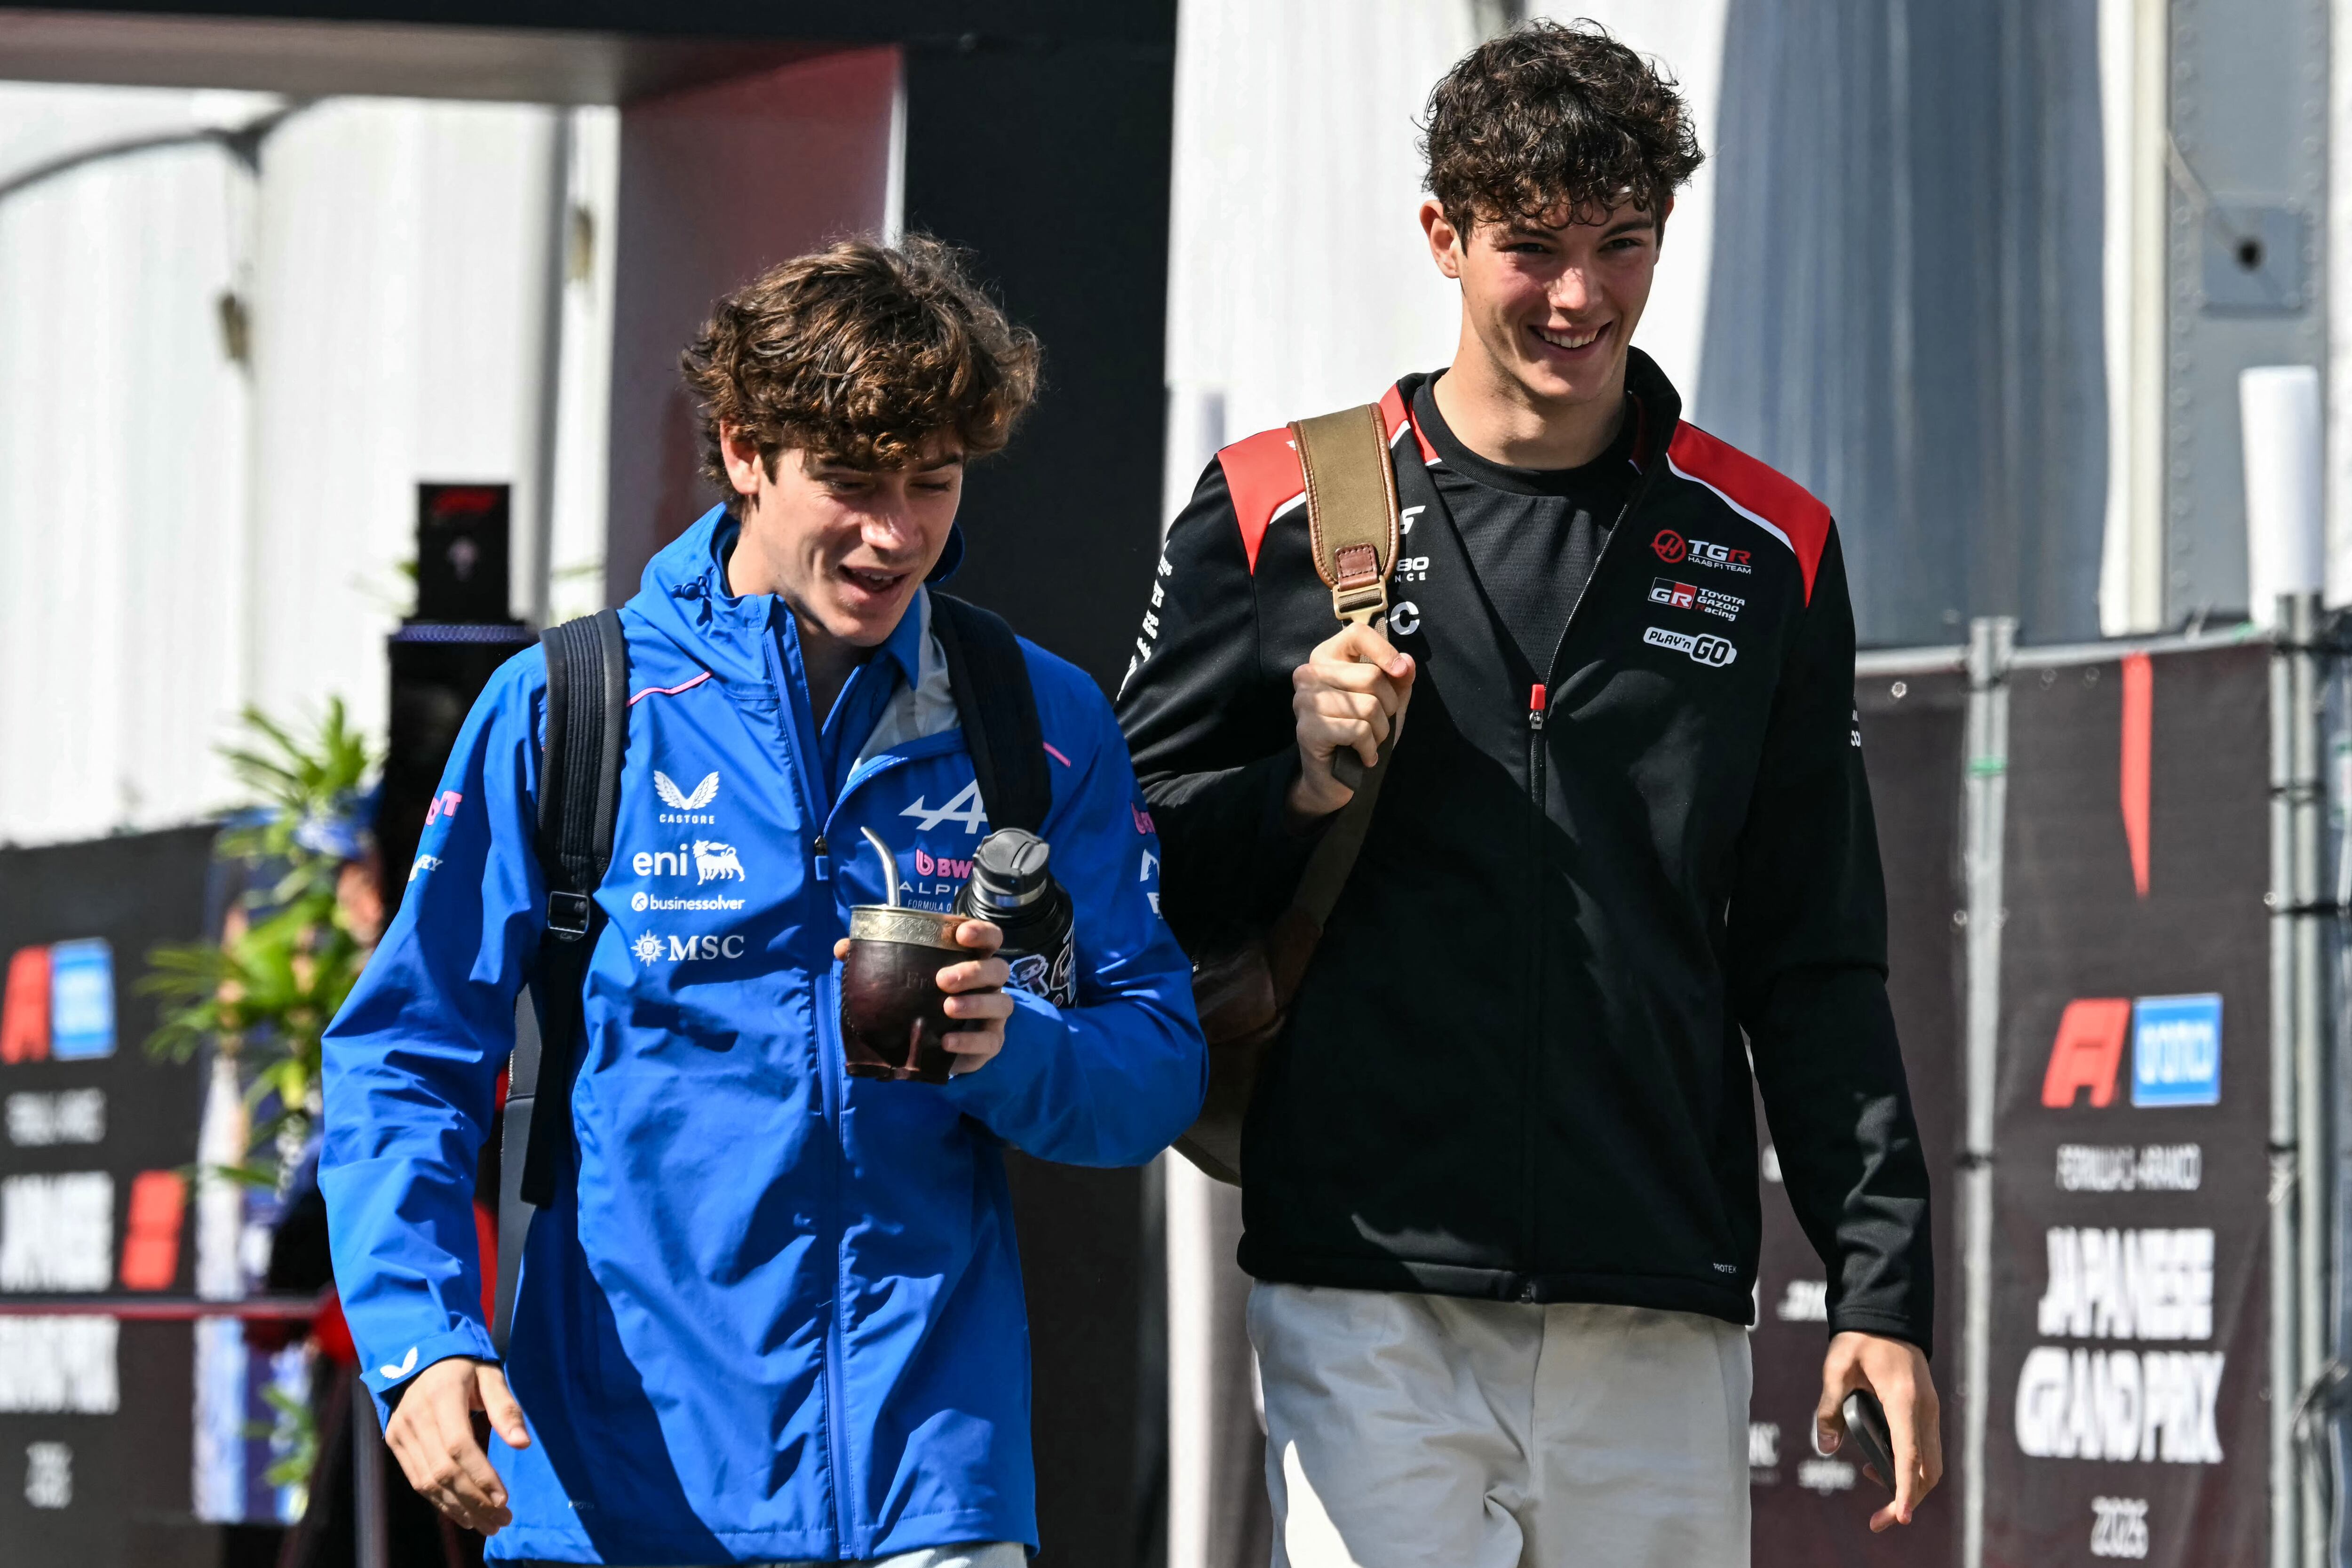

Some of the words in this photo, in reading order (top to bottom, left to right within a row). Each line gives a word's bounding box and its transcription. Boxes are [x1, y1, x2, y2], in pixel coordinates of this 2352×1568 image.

[1688, 540, 1751, 565] TGR
[1688, 556, 1713, 568] HAAS
[1725, 565, 1751, 574] TEAM
[1651, 588, 1692, 607] GR
[1697, 596, 1740, 613] GAZOO
[1700, 588, 1745, 606] TOYOTA
[1695, 604, 1736, 621] Racing
[1692, 637, 1730, 664] GO
[659, 814, 715, 824] CASTORE
[633, 844, 688, 876] eni
[937, 858, 973, 879] BW
[899, 881, 960, 897] ALPI
[650, 894, 746, 910] businessolver
[908, 899, 943, 912] FORMULA
[667, 935, 744, 961] MSC
[2038, 1226, 2215, 1340] JAPANESE
[2015, 1346, 2141, 1461] GRAND
[2140, 1350, 2225, 1464] PRIX
